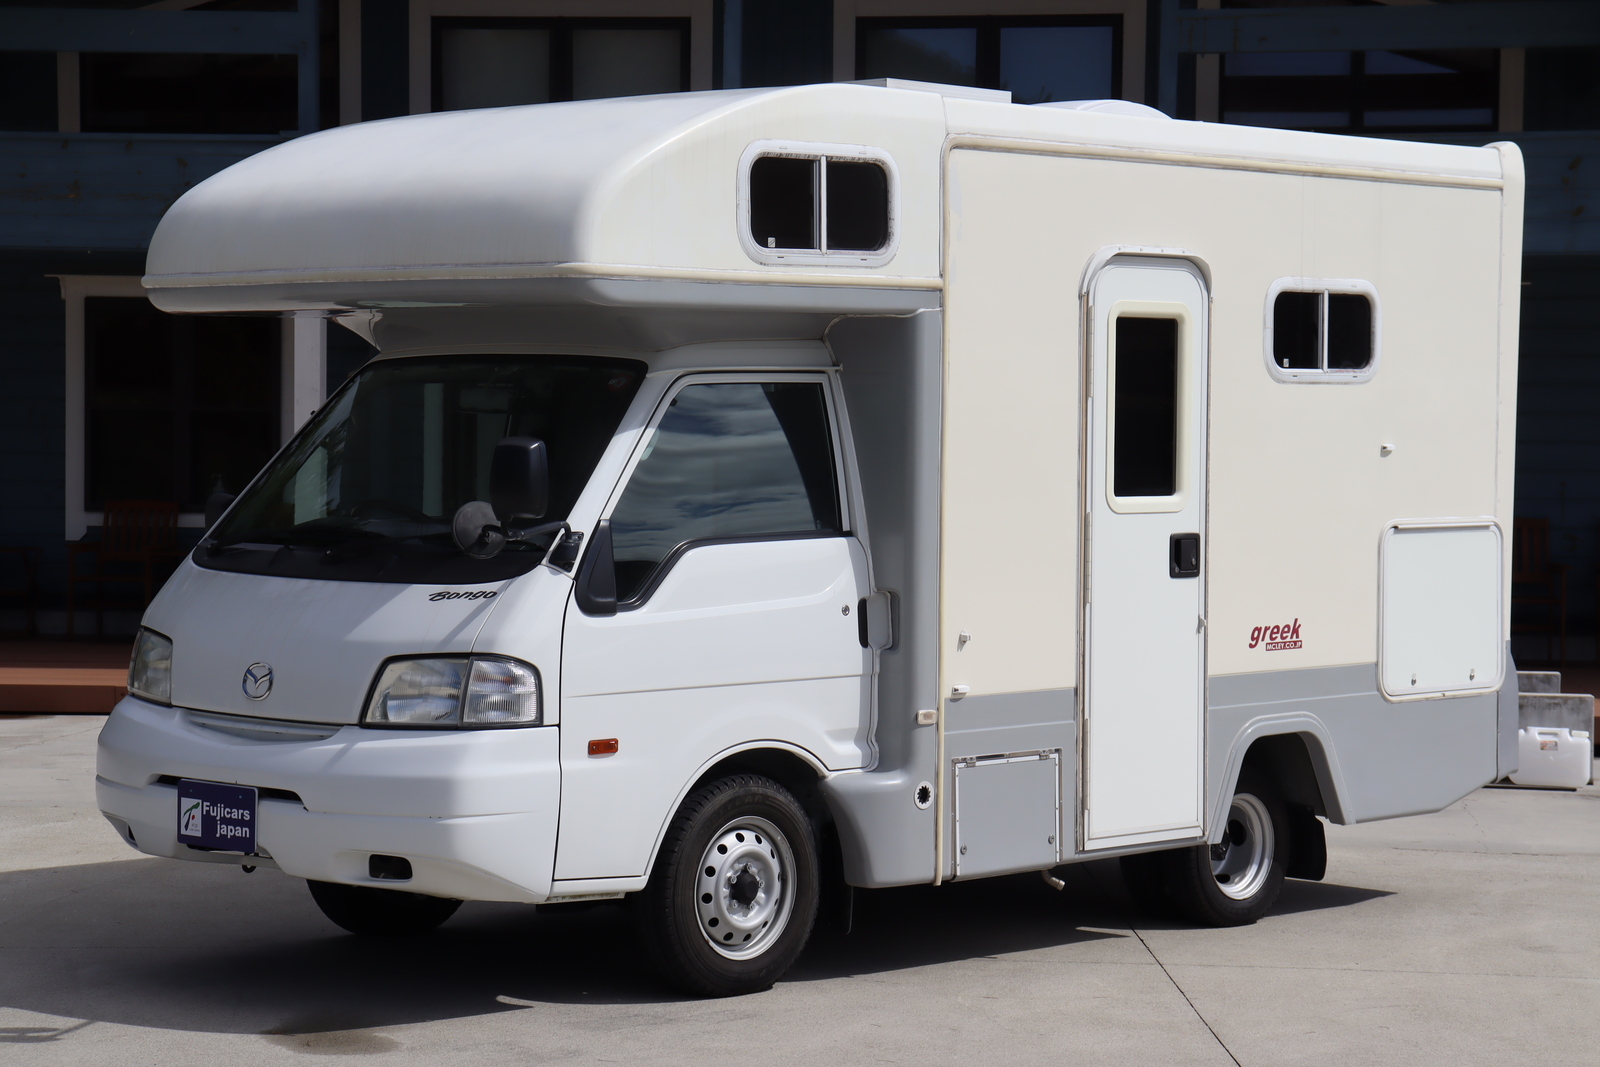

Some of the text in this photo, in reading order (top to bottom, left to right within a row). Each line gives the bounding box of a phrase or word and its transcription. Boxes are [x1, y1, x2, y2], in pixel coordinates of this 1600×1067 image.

[428, 590, 498, 602] Bongo
[1248, 617, 1302, 650] greek
[203, 801, 251, 821] Fujicars
[215, 820, 250, 839] japan
